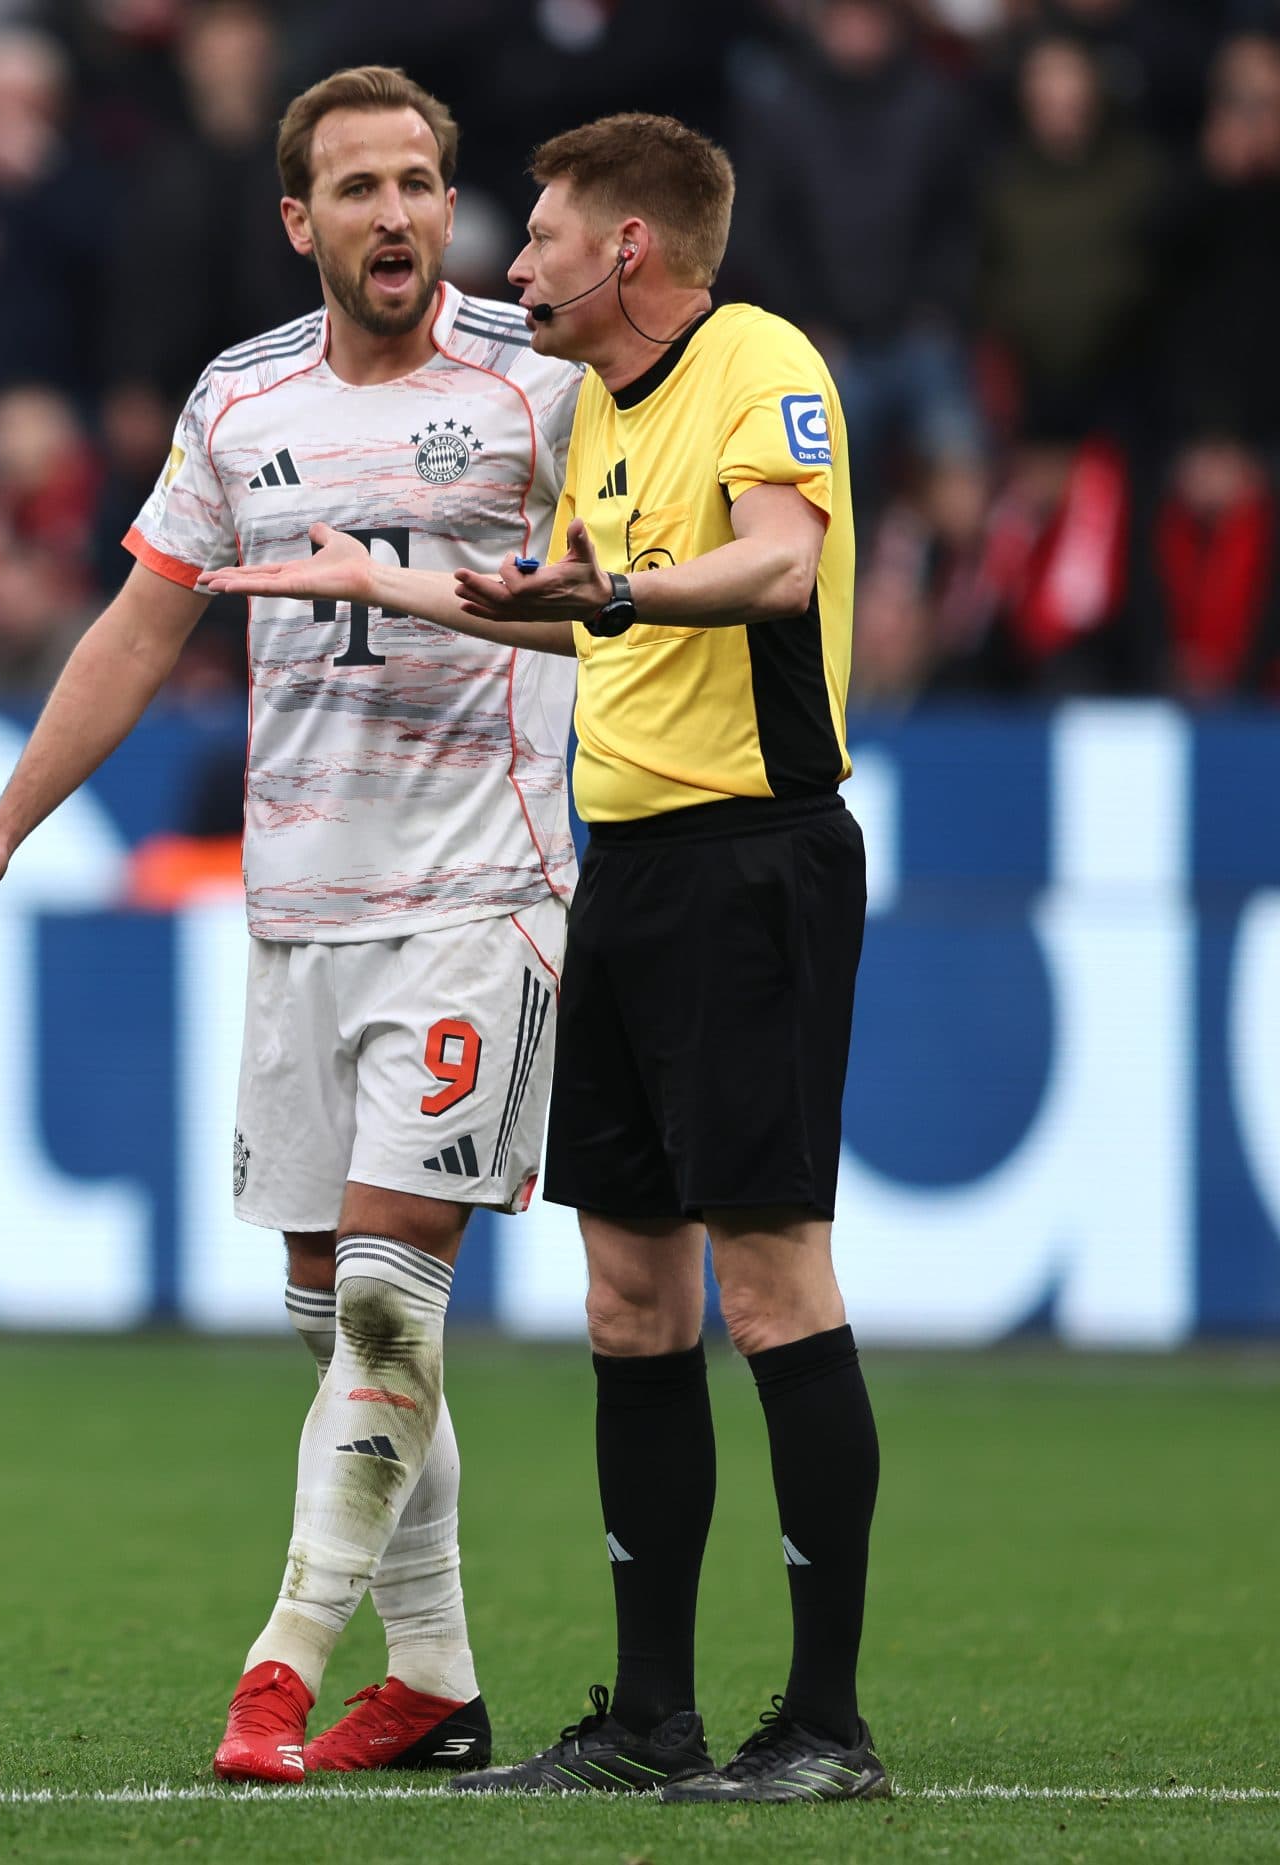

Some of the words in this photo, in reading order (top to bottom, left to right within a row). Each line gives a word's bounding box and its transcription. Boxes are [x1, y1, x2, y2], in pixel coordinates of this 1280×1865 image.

[434, 437, 465, 458] BAYERN
[799, 451, 816, 459] Das
[420, 1017, 483, 1117] 9
